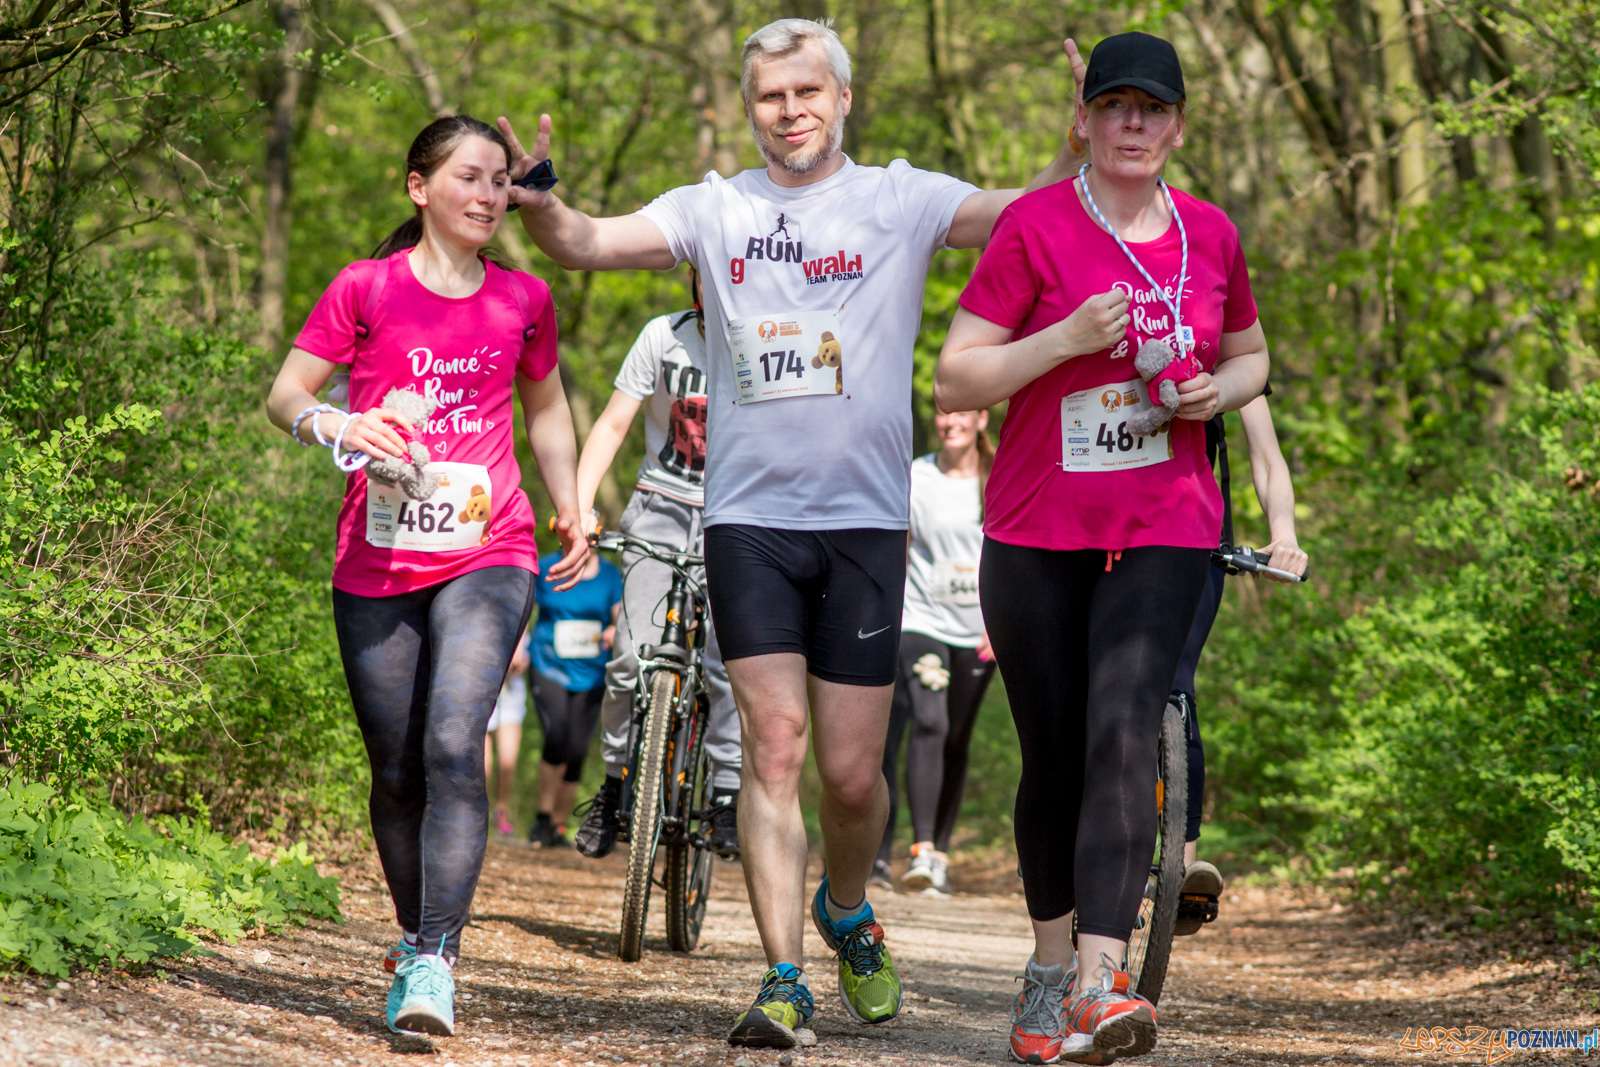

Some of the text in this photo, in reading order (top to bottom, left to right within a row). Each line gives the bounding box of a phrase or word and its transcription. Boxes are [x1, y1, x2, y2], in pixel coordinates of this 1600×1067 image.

[745, 236, 803, 263] RUN
[806, 275, 827, 285] TEAM
[1133, 306, 1169, 335] Run
[406, 347, 481, 377] Dance
[1110, 340, 1128, 360] &
[759, 350, 805, 382] 174
[424, 377, 464, 409] Run
[445, 405, 483, 434] Fun
[398, 502, 454, 533] 462
